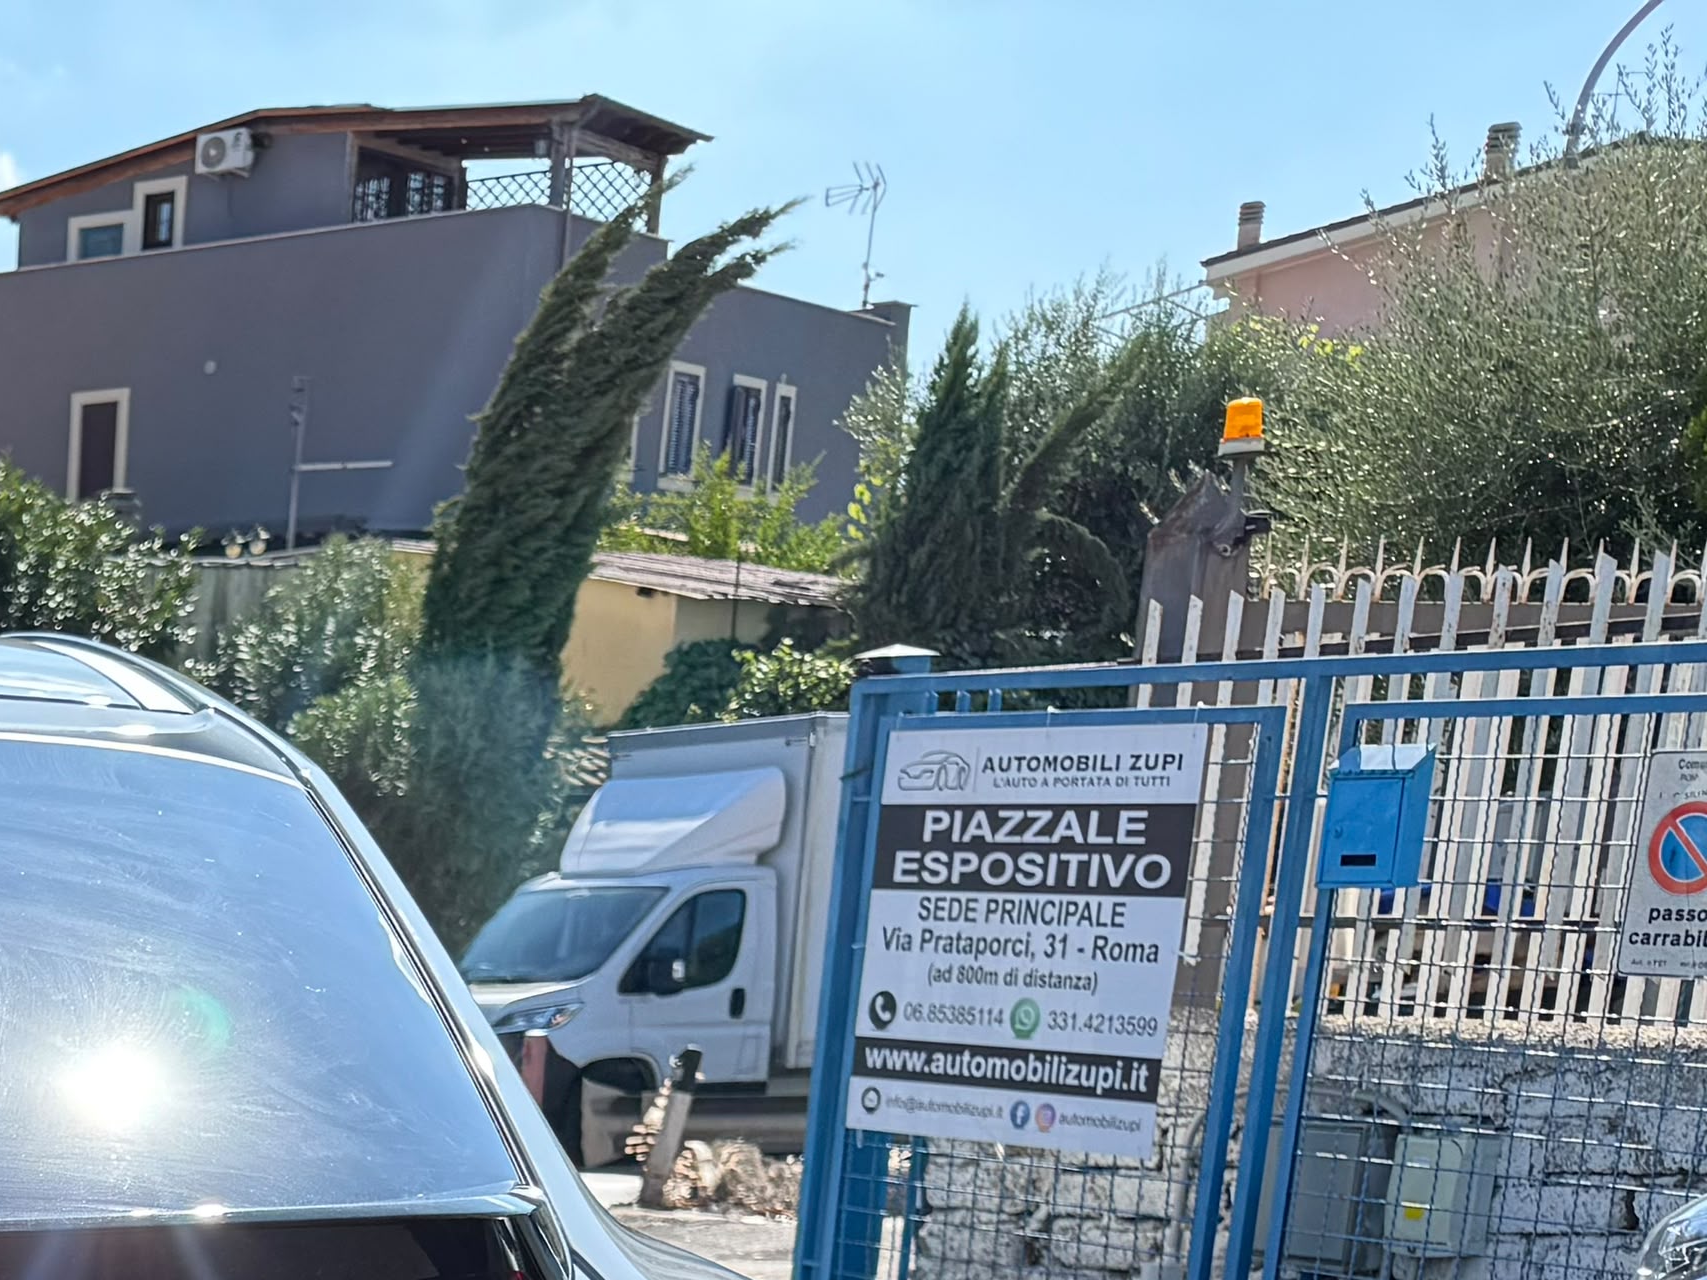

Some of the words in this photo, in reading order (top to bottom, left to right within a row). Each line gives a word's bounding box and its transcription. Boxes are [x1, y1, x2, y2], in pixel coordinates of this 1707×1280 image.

[982, 753, 1121, 774] AUTOMOBILI
[1129, 753, 1184, 771] ZUPI
[993, 777, 1037, 788] L'AUTO
[1041, 777, 1049, 787] A
[1053, 776, 1111, 788] PORTATA
[1115, 776, 1128, 786] DI
[1134, 776, 1170, 787] TUTTI
[922, 809, 1149, 845] PIAZZALE
[892, 850, 1172, 889] ESPOSITIVO
[918, 897, 978, 923] SEDE
[985, 899, 1127, 928] PRINCIPALE
[1648, 907, 1707, 924] passo
[883, 926, 912, 951] Via
[919, 928, 1035, 960] Prataporci,
[1044, 933, 1069, 958] 31
[1091, 936, 1159, 964] Roma
[928, 965, 952, 987] (ad
[957, 966, 998, 987] 800m
[1003, 967, 1018, 986] di
[1023, 968, 1099, 995] distanza)
[903, 1002, 1004, 1026] 06.85385114
[1047, 1010, 1158, 1037] 331.4213599
[865, 1045, 1149, 1095] www.automobilizupi.it
[1059, 1112, 1141, 1133] automobilizupi
